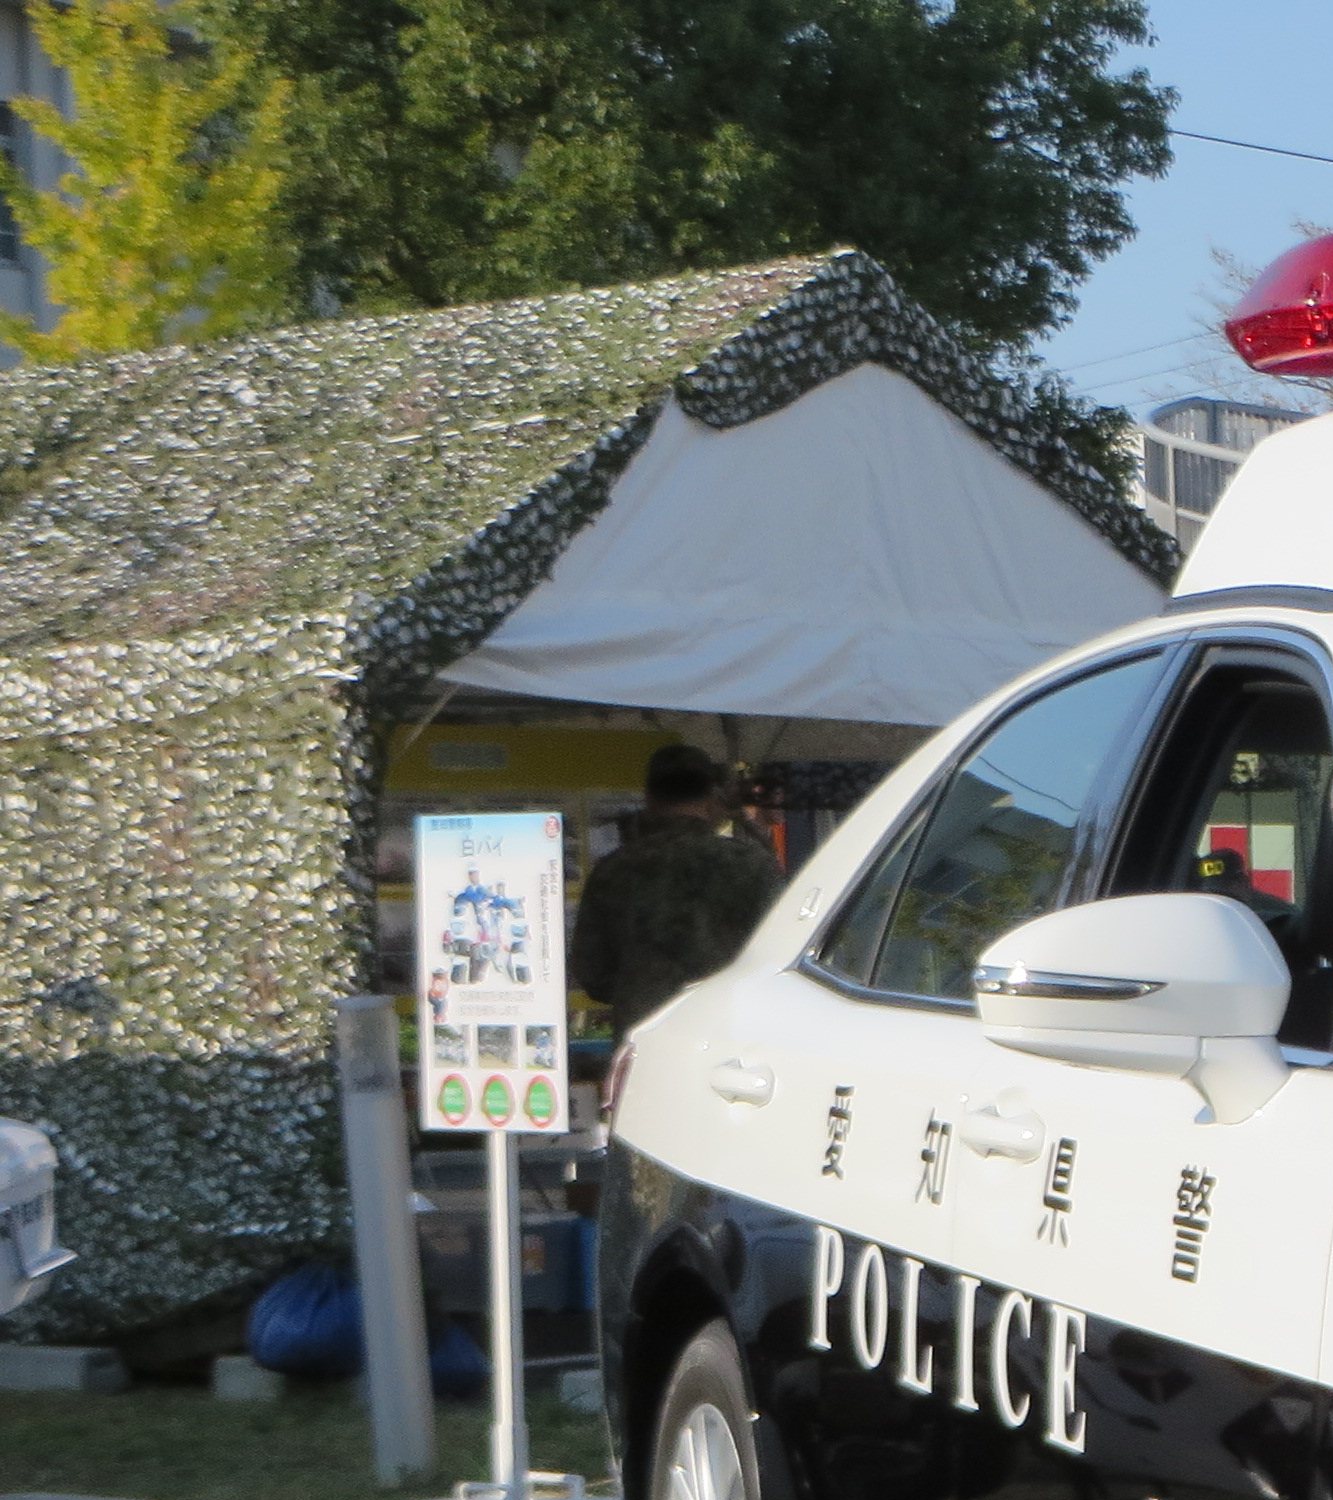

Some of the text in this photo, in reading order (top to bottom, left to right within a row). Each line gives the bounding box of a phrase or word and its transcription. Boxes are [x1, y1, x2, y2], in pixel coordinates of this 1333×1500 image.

[460, 835, 504, 857] 白バイ
[822, 1084, 1217, 1284] 愛知県警
[809, 1223, 1087, 1454] POLICE
